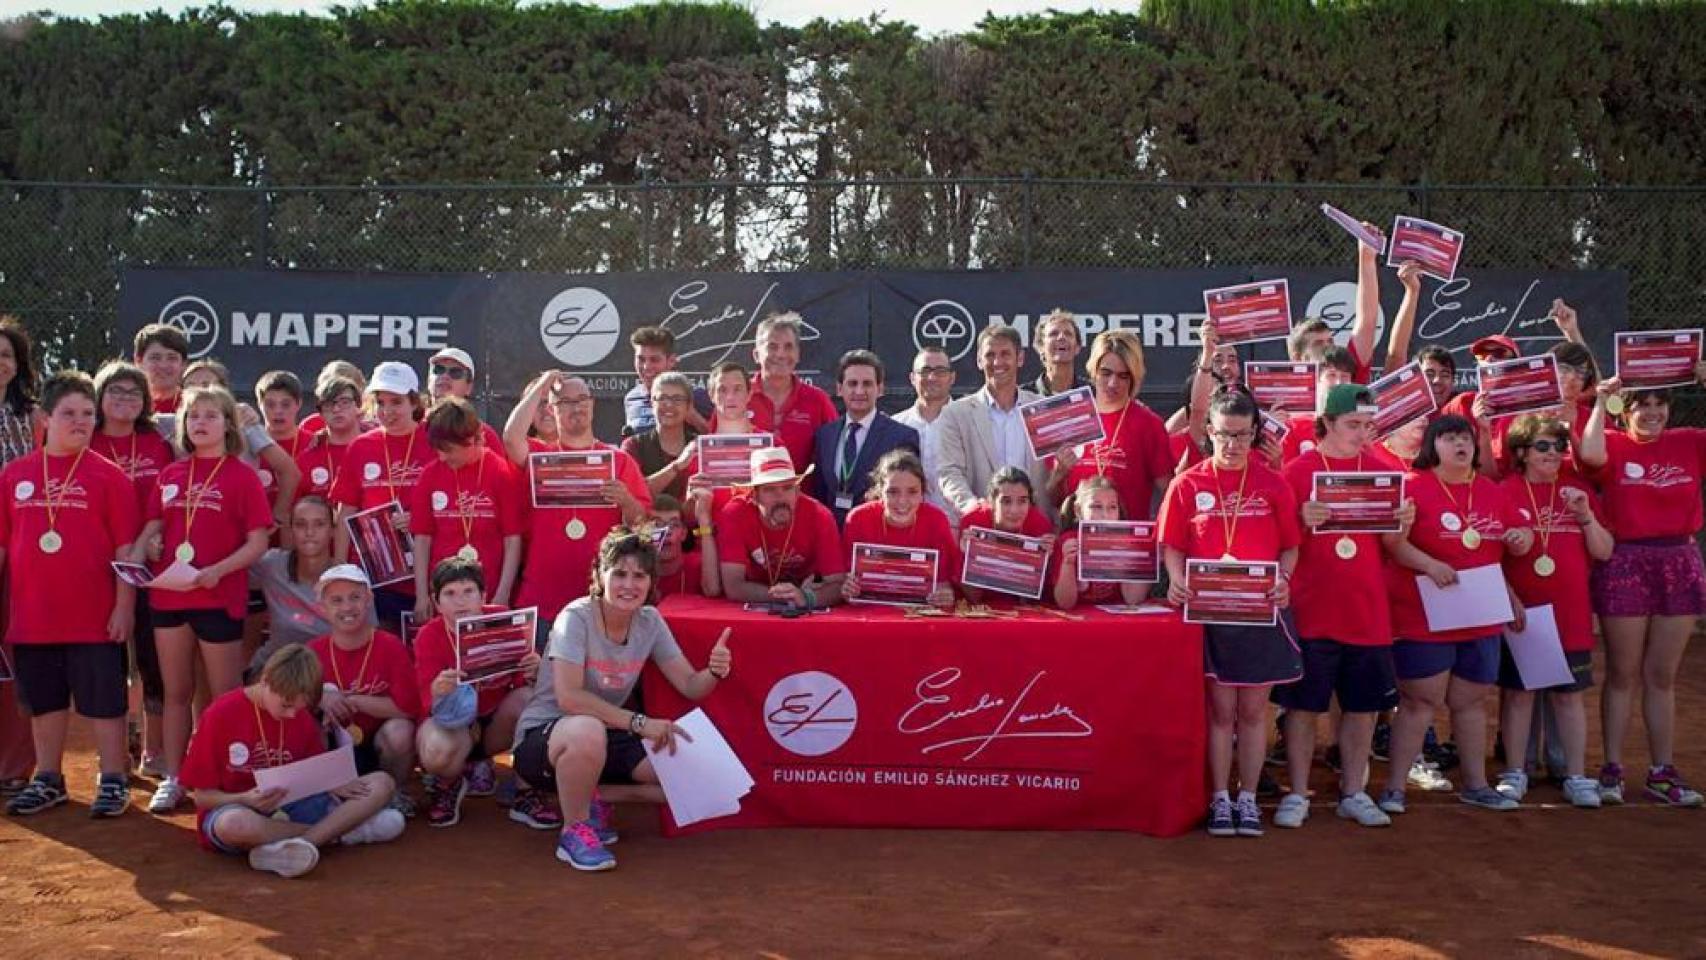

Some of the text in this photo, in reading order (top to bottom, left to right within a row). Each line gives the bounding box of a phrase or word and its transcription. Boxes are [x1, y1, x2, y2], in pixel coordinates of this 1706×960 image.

[231, 311, 449, 350] MAPFRE
[988, 313, 1208, 347] MPFRE
[772, 767, 1081, 791] FUNDACIÓN EMILIO SÁNCHEZ VICARIO
